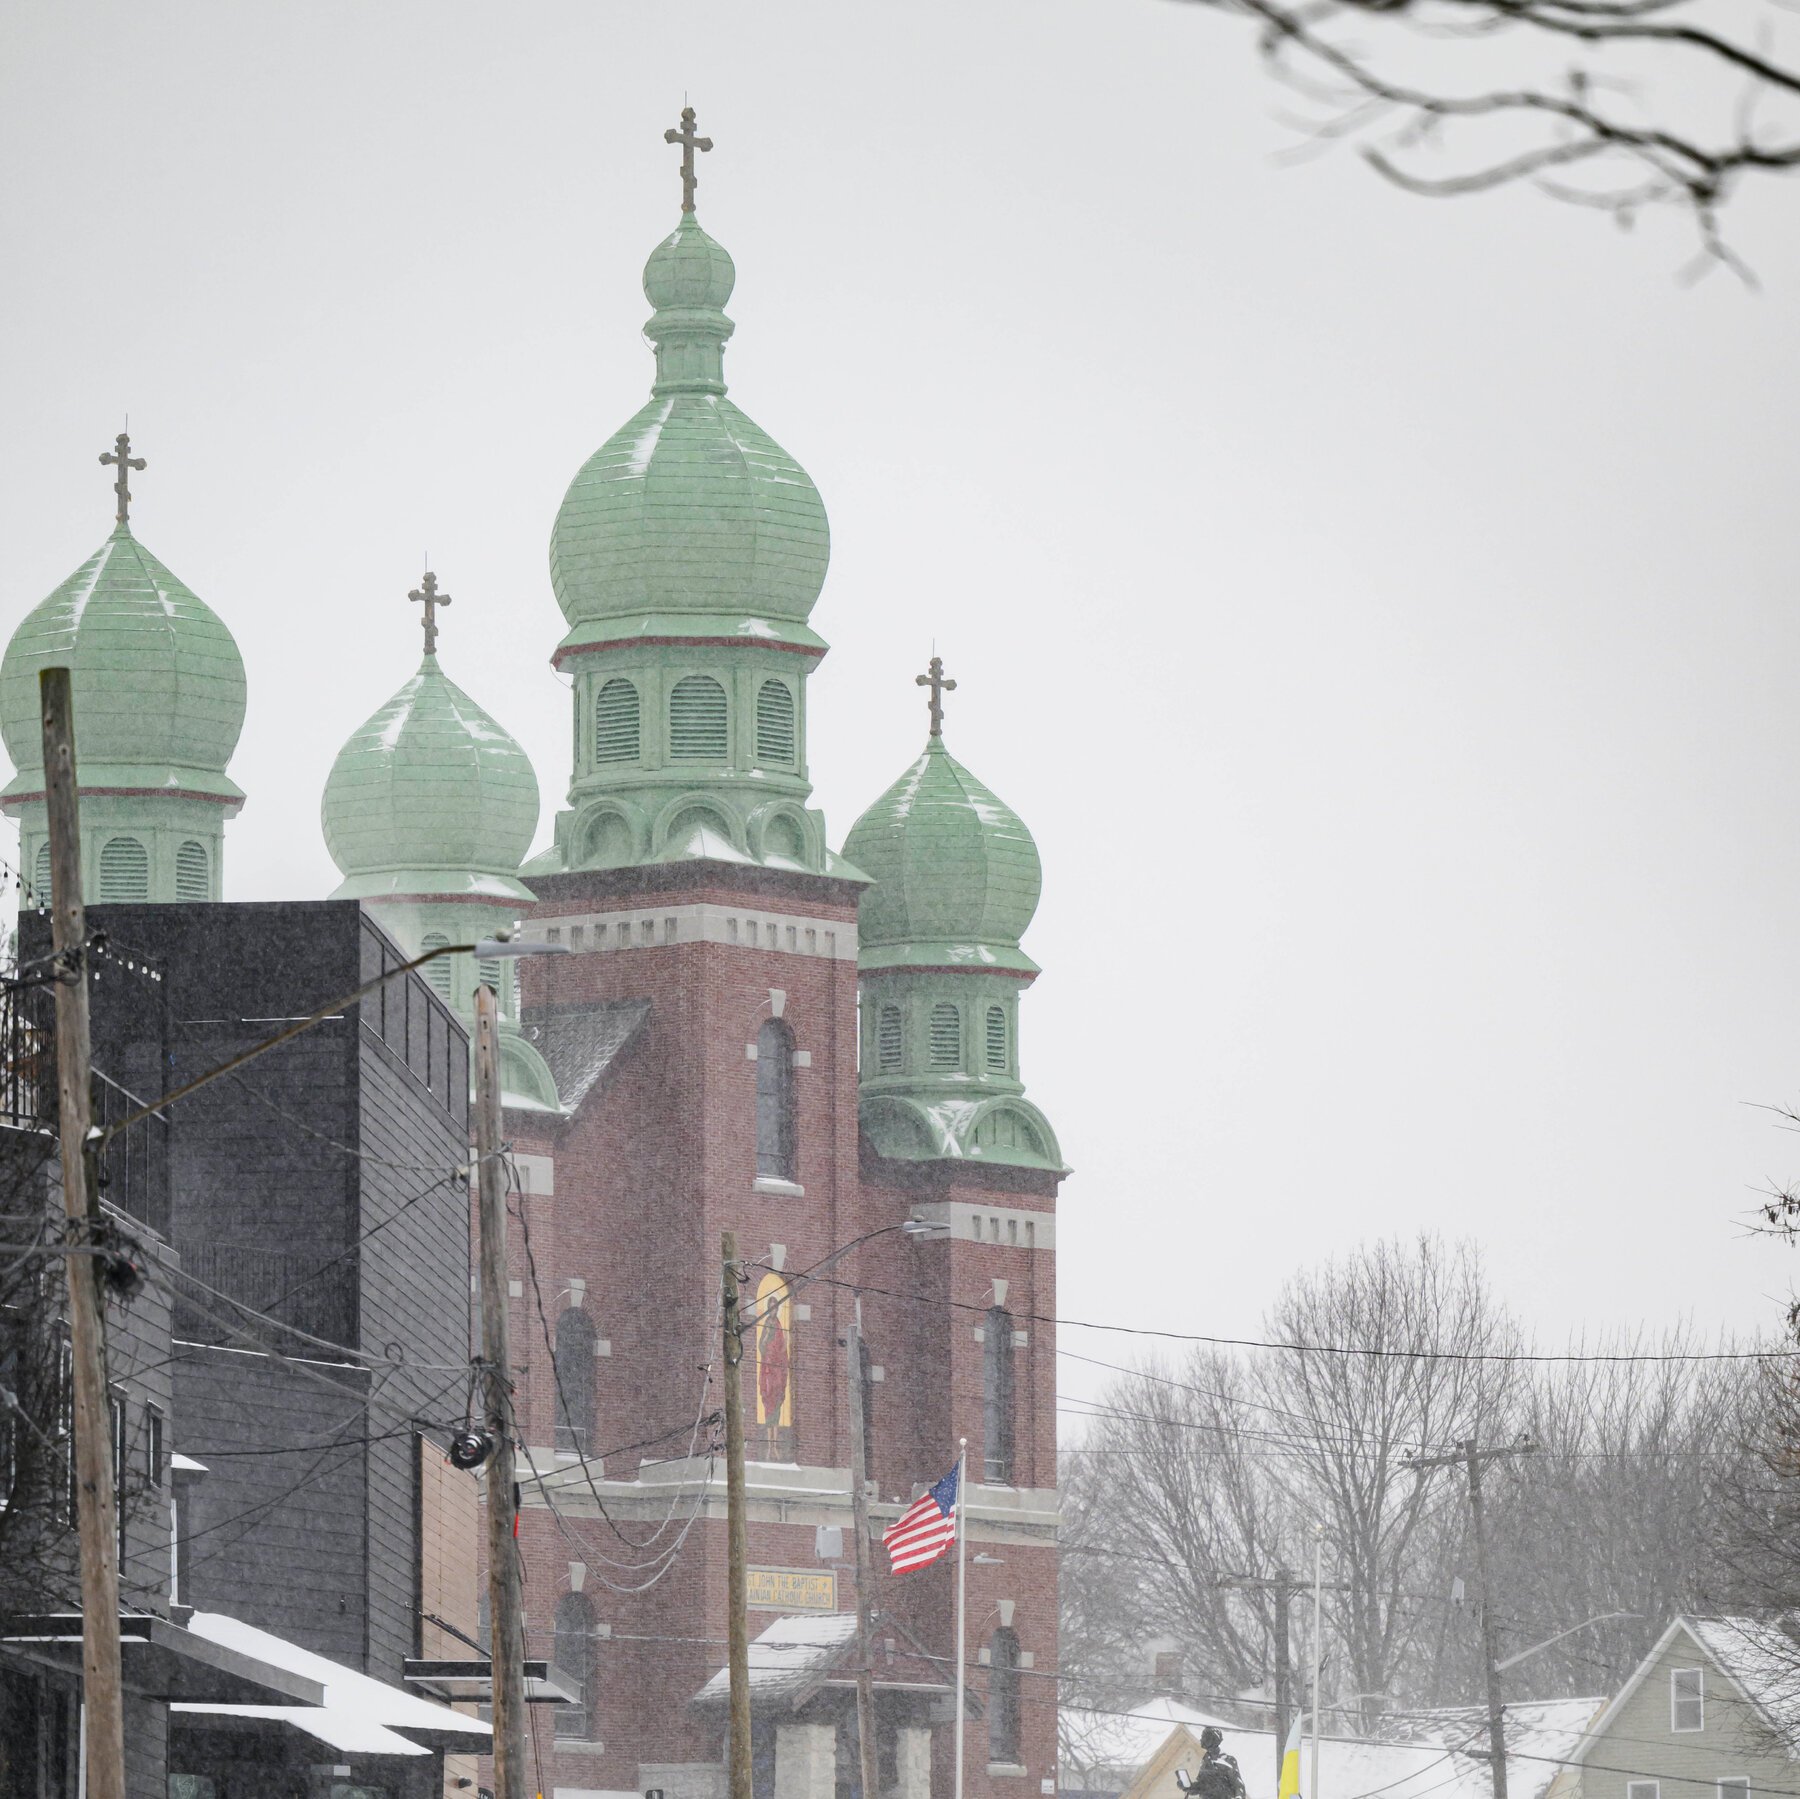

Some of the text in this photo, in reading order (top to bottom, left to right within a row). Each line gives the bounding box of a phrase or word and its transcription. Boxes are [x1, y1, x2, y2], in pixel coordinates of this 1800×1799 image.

[759, 1574, 775, 1588] JOHN
[777, 1575, 789, 1589] THE
[792, 1576, 818, 1591] BAPTIST
[748, 1588, 831, 1605] AINIAN CATHOLIC CHURCH
